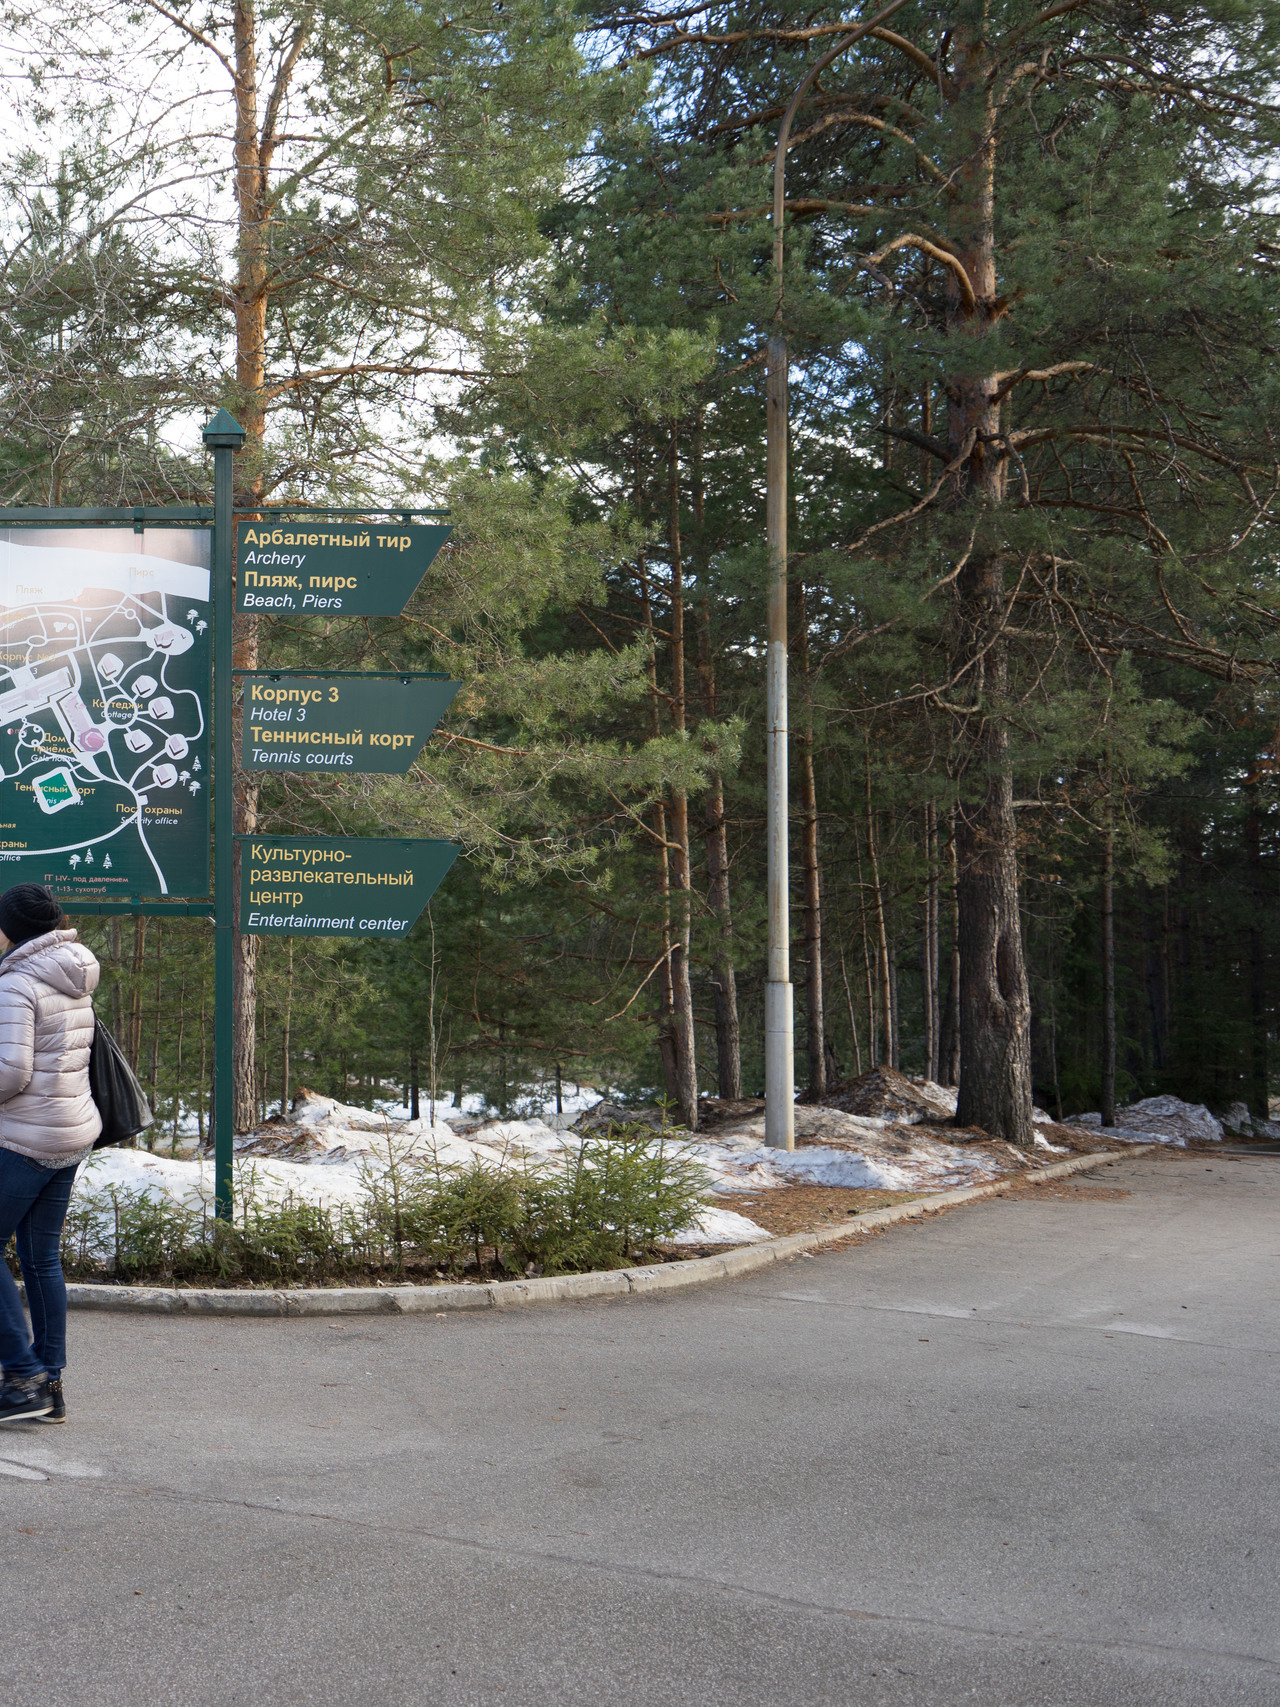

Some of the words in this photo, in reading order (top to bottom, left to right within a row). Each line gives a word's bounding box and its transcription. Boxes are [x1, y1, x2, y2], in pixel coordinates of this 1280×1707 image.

[244, 528, 371, 548] Арбалетный
[376, 534, 412, 550] тир
[244, 551, 306, 569] Archery
[244, 571, 304, 590] Пляж,
[309, 575, 358, 593] пирс
[243, 593, 297, 609] Beach,
[302, 594, 343, 609] Piers
[32, 667, 38, 675] 3
[251, 684, 323, 706] Корпус
[328, 686, 339, 703] 3
[250, 706, 291, 722] Hotel
[296, 708, 306, 722] 3
[44, 732, 66, 743] Дом
[250, 725, 363, 746] Теннисный
[369, 733, 415, 751] корт
[251, 749, 301, 764] Tennis
[305, 752, 354, 766] courts
[144, 807, 183, 816] охраны
[154, 817, 179, 825] office
[251, 844, 352, 866] Культурно-
[250, 868, 414, 888] развлекательный
[75, 885, 107, 894] сухотруб
[250, 889, 304, 907] центр
[248, 912, 357, 929] Entertainment
[361, 916, 409, 931] center
